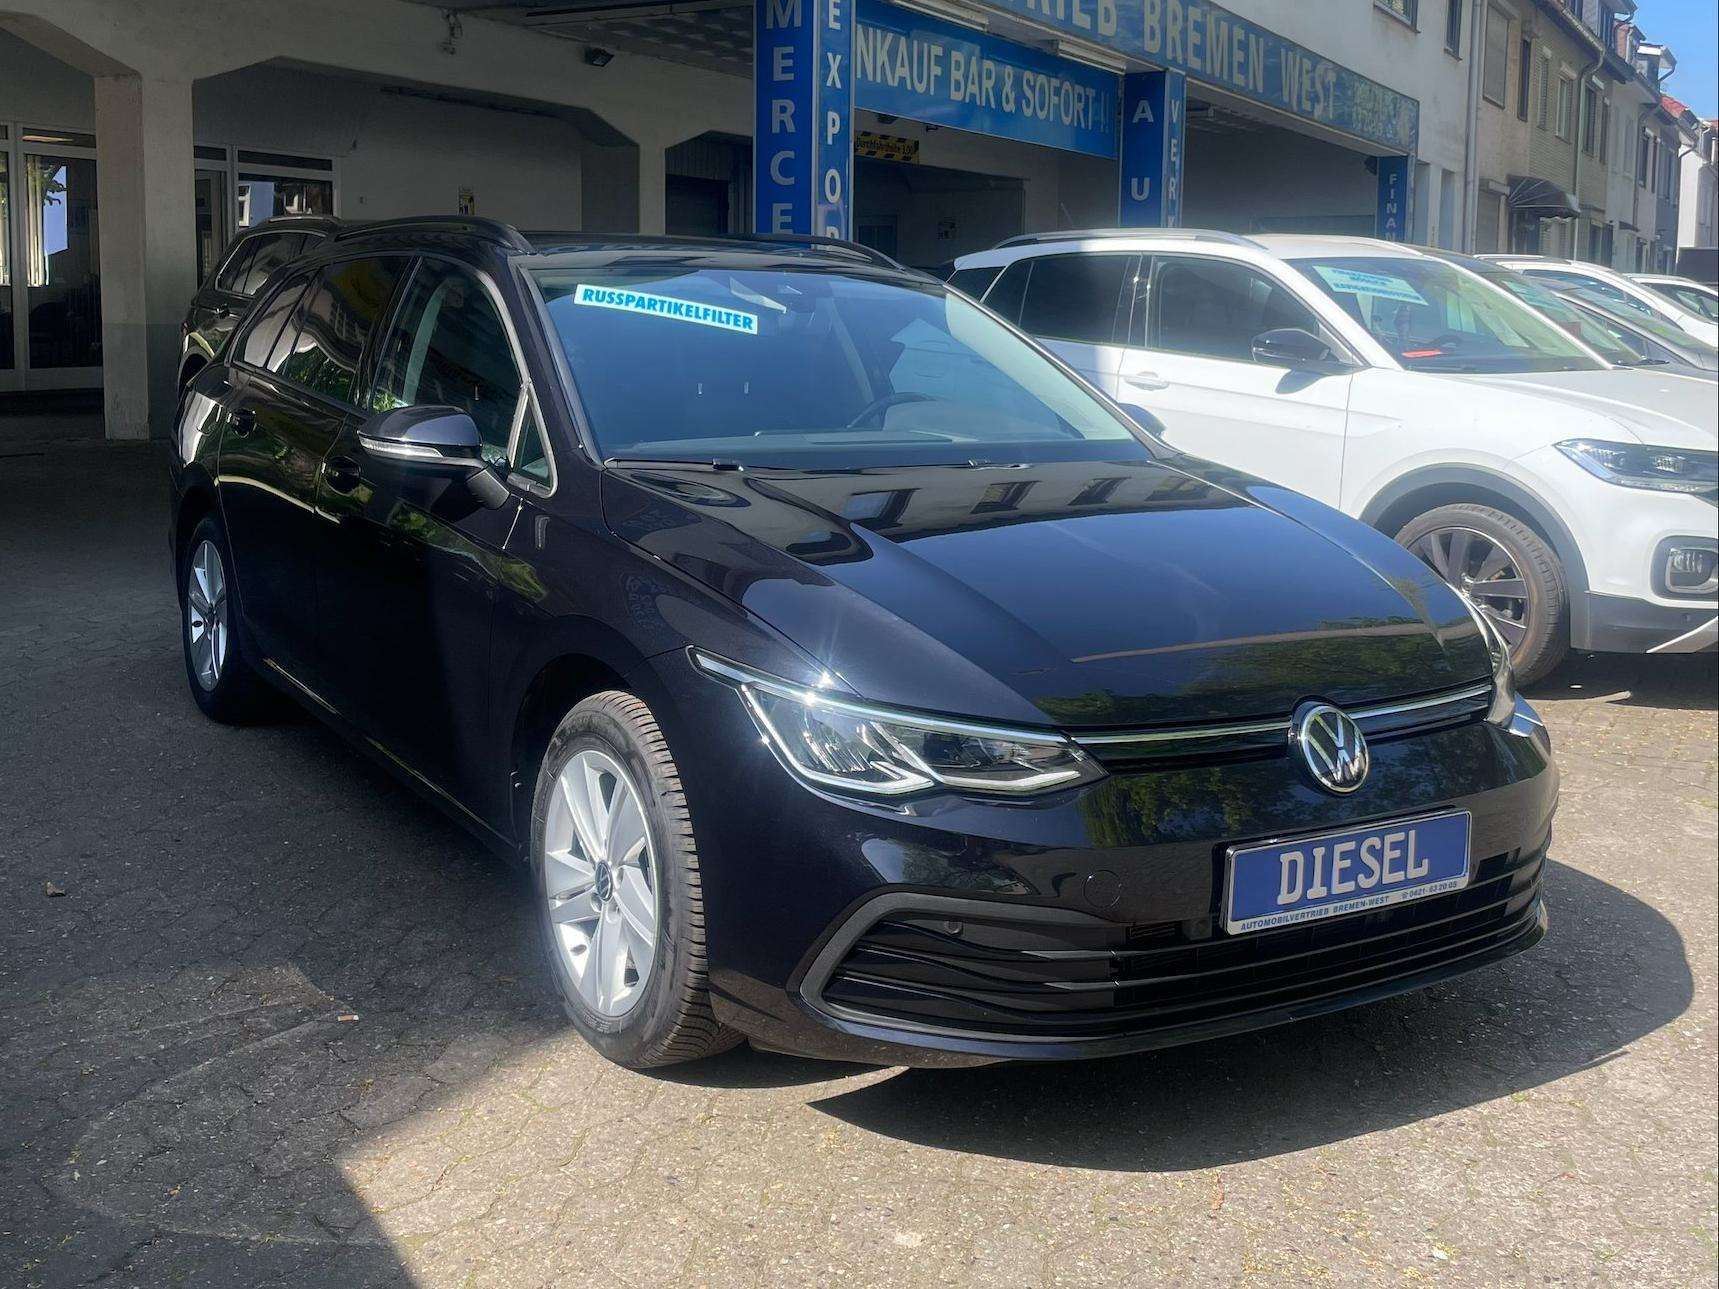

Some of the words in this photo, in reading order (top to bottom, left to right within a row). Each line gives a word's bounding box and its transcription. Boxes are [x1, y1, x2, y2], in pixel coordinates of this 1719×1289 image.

[856, 24, 943, 95] NKAUF
[950, 50, 996, 109] BAR
[1002, 65, 1016, 113] &
[1143, 0, 1264, 93] BREMEN
[1280, 48, 1337, 120] WEST
[765, 0, 802, 235] MERCE
[582, 288, 753, 330] RUSSPARTIKELFILTER
[1277, 829, 1429, 905] DIESEL
[1240, 907, 1329, 931] AUTOMOBILVERTRIEB
